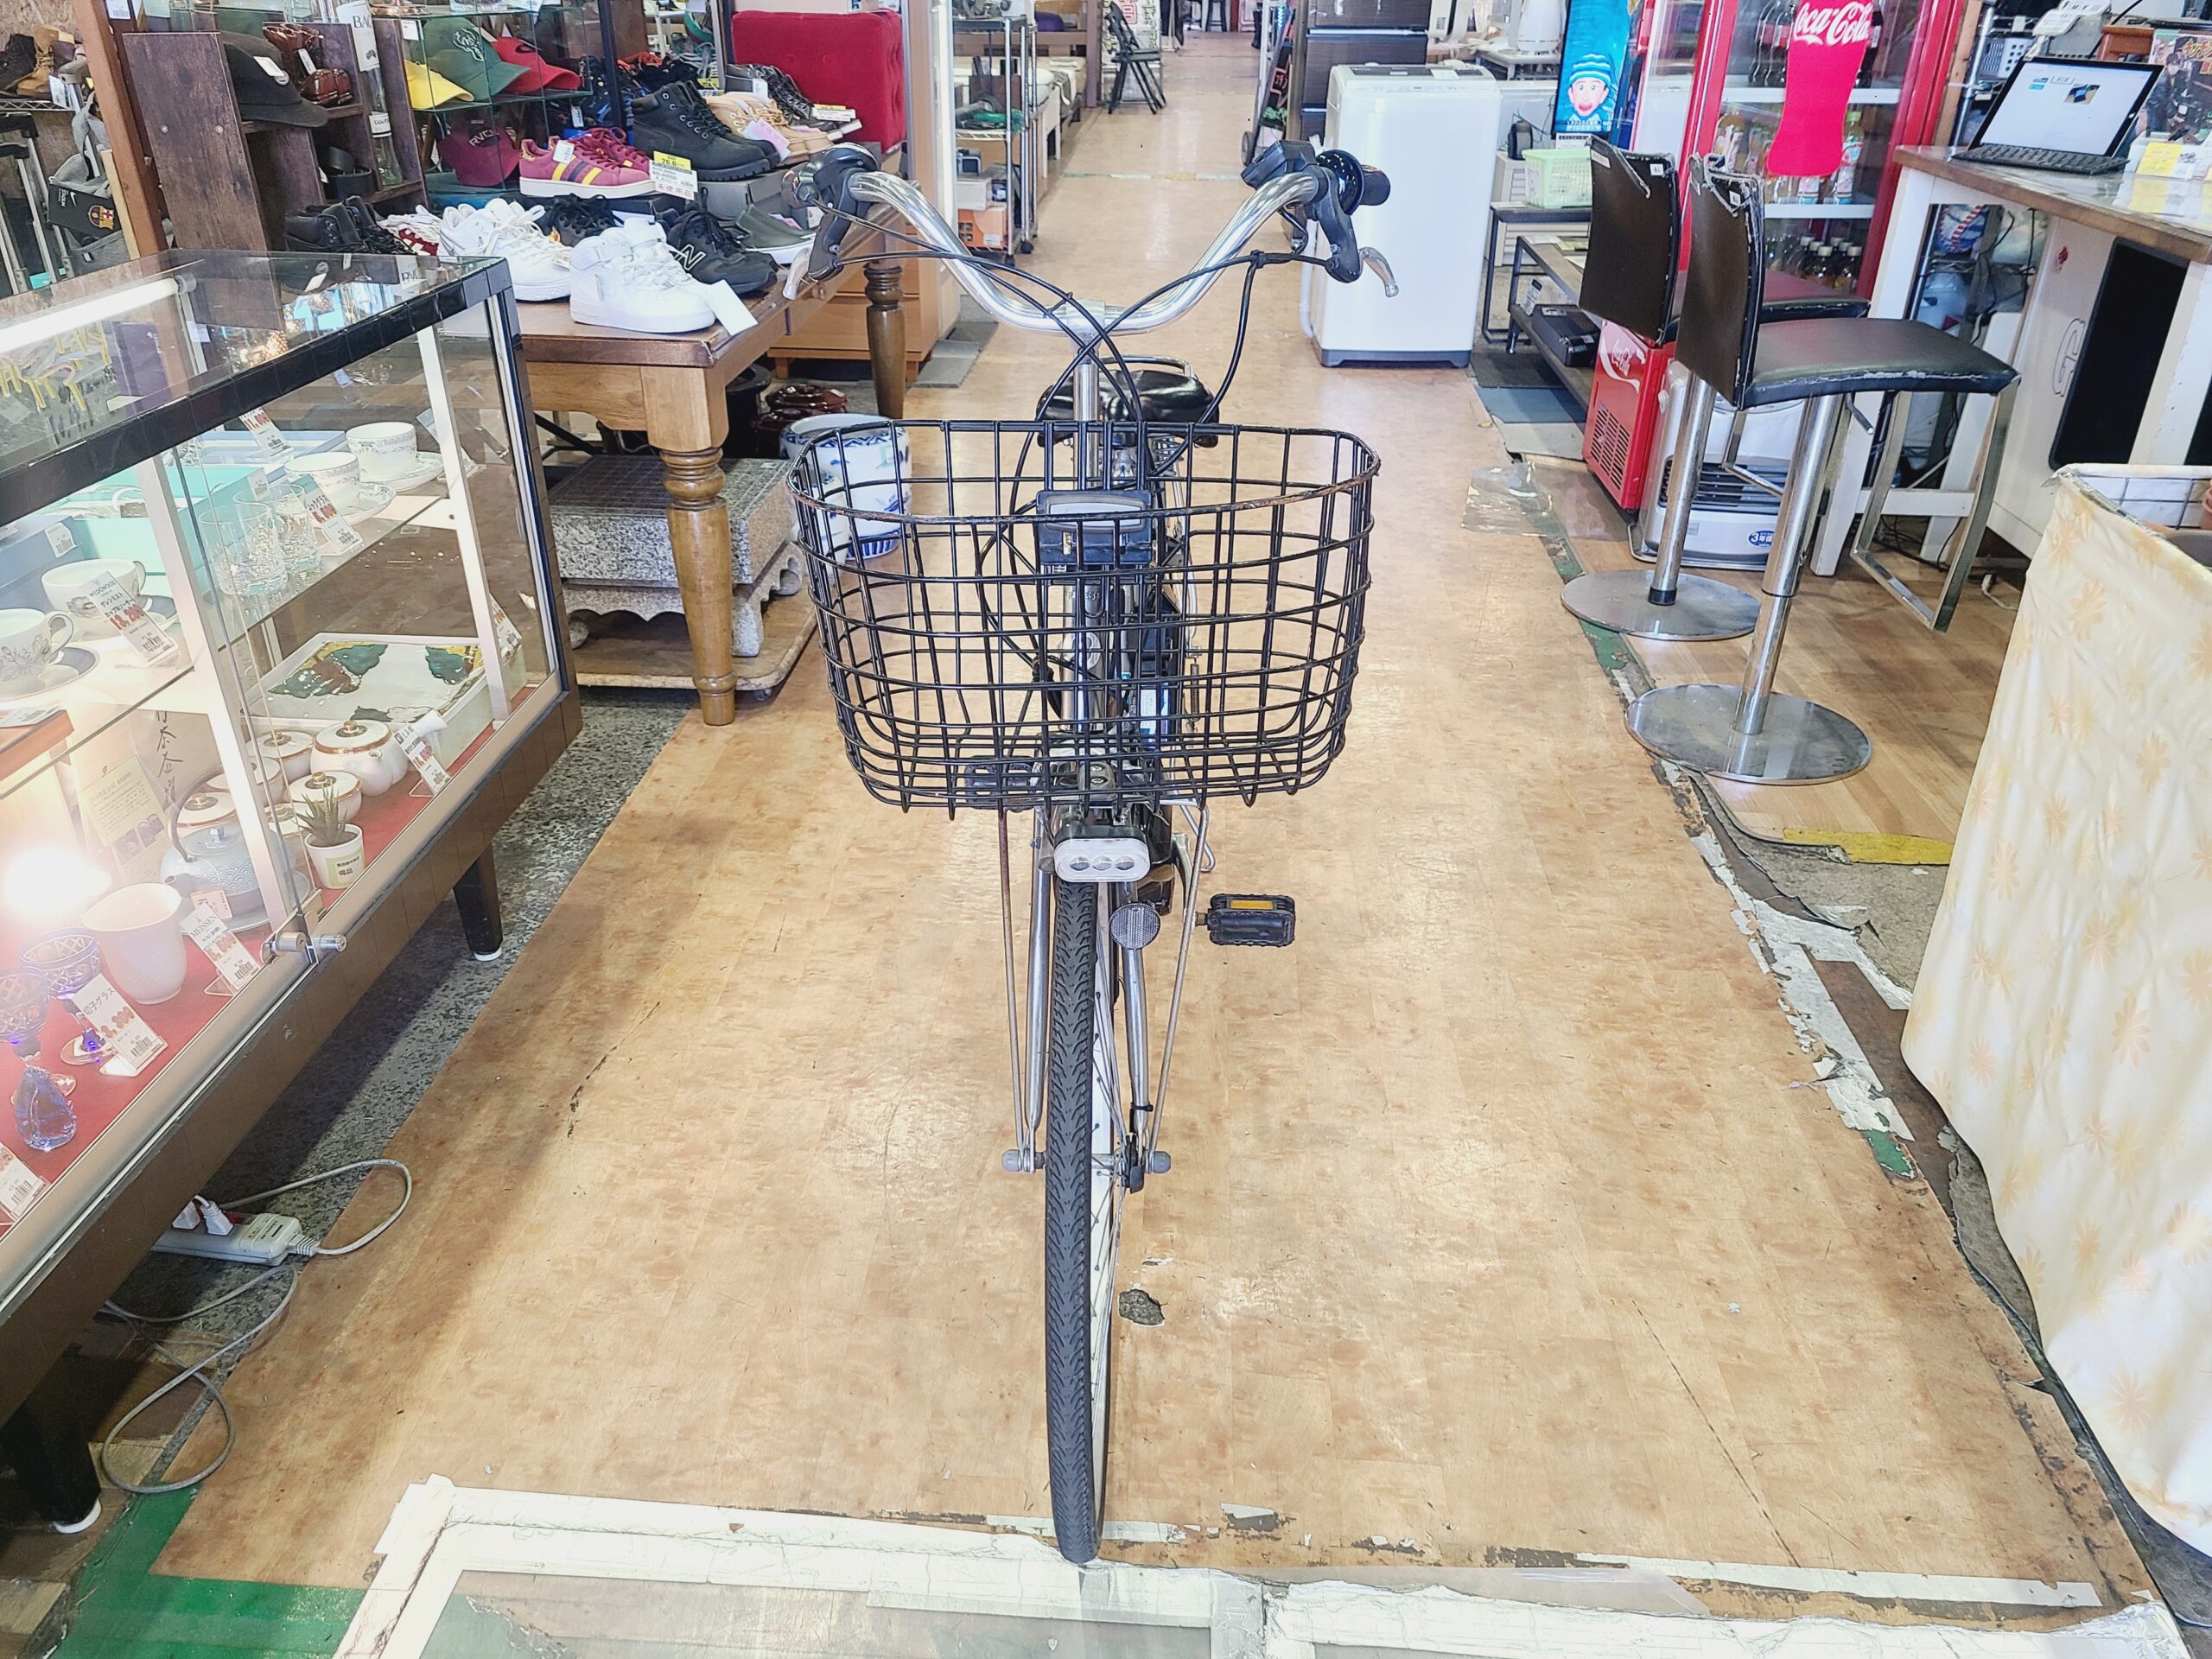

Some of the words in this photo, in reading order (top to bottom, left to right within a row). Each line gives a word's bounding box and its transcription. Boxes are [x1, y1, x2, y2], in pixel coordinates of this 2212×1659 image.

[1794, 2, 1873, 46] Coca-Cola
[190, 915, 218, 937] MEISSEN
[83, 988, 115, 1016] 切子グラス
